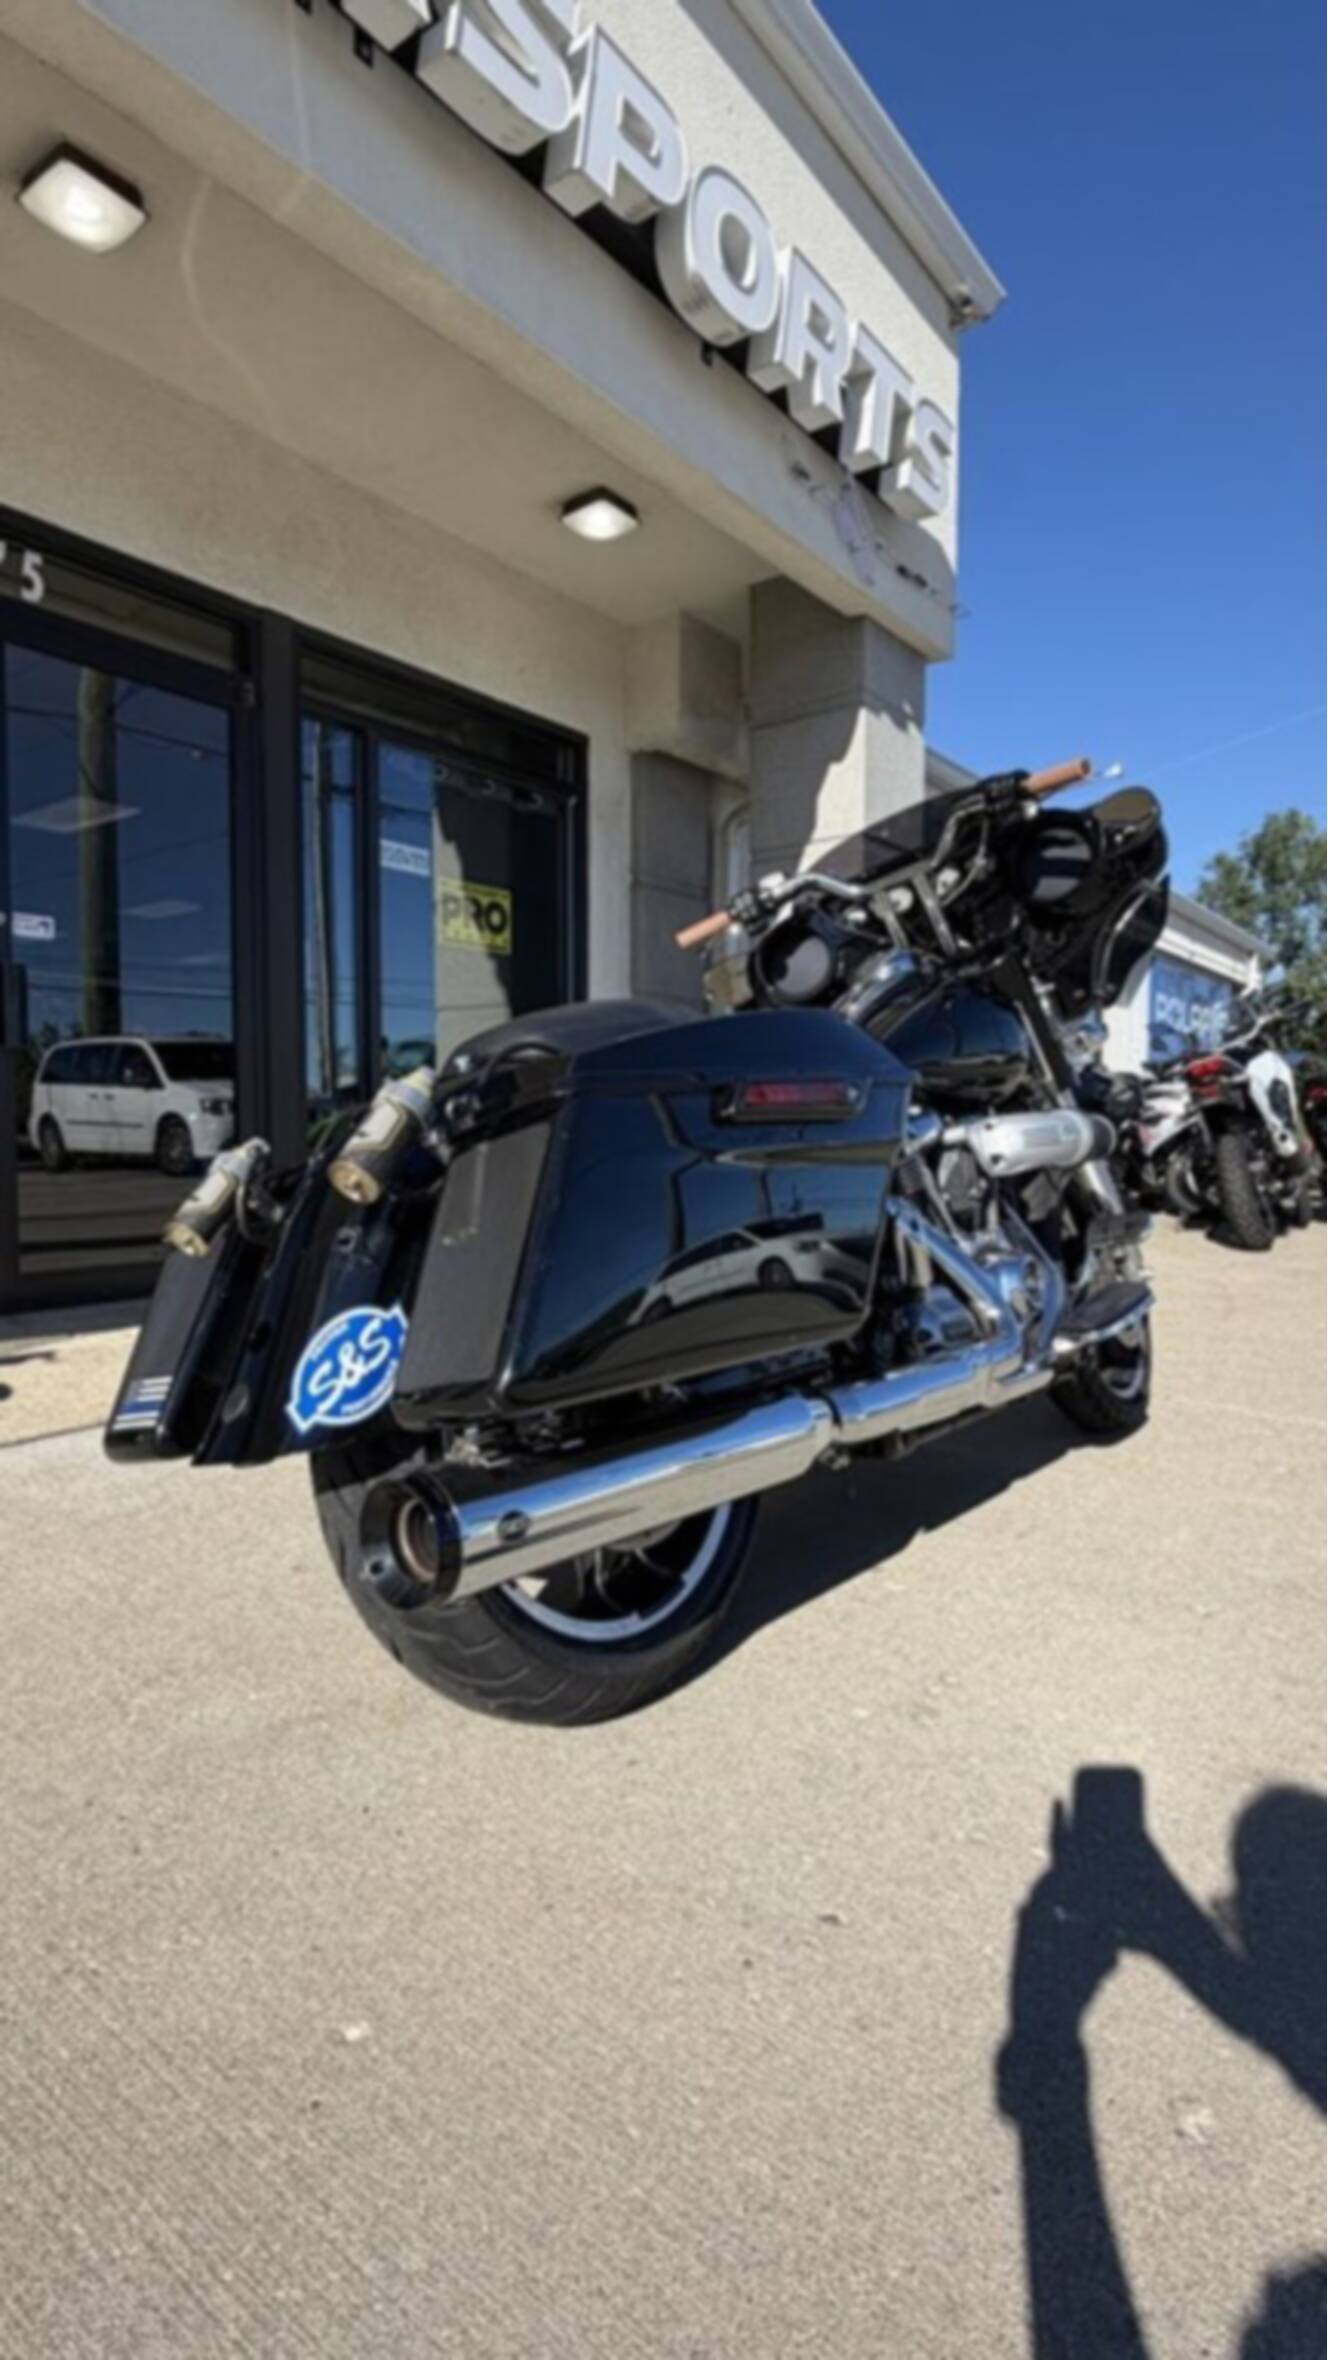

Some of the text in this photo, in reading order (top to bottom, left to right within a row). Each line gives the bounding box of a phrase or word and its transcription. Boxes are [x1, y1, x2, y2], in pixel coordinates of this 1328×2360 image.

[338, 0, 957, 521] SPORTS
[0, 541, 44, 603] 5
[442, 895, 508, 935] PRO
[307, 1316, 391, 1414] S&S
